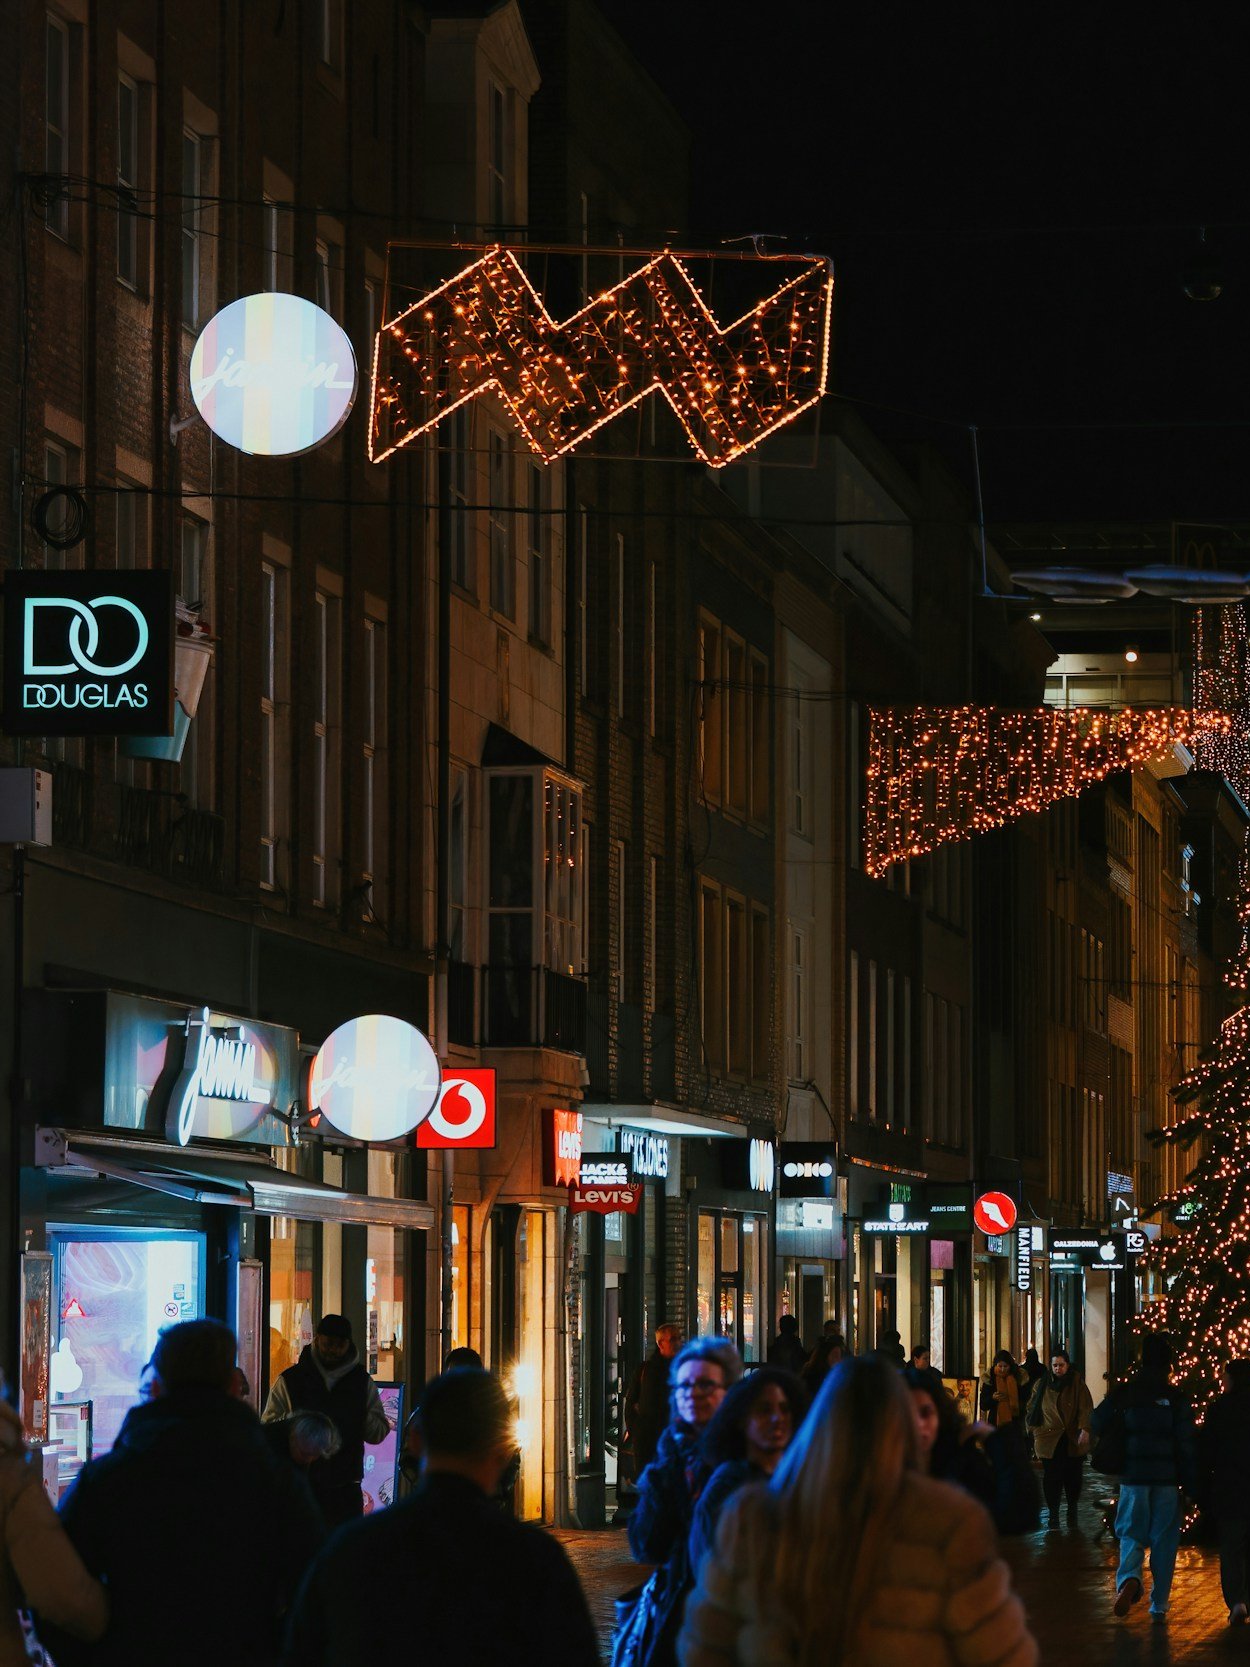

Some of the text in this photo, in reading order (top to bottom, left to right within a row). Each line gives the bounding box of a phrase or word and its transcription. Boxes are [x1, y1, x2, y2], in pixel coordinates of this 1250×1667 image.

[23, 684, 148, 708] DOUGLAS
[1053, 1240, 1099, 1248] CALZEDONIA
[1018, 1227, 1031, 1291] MANFIELD
